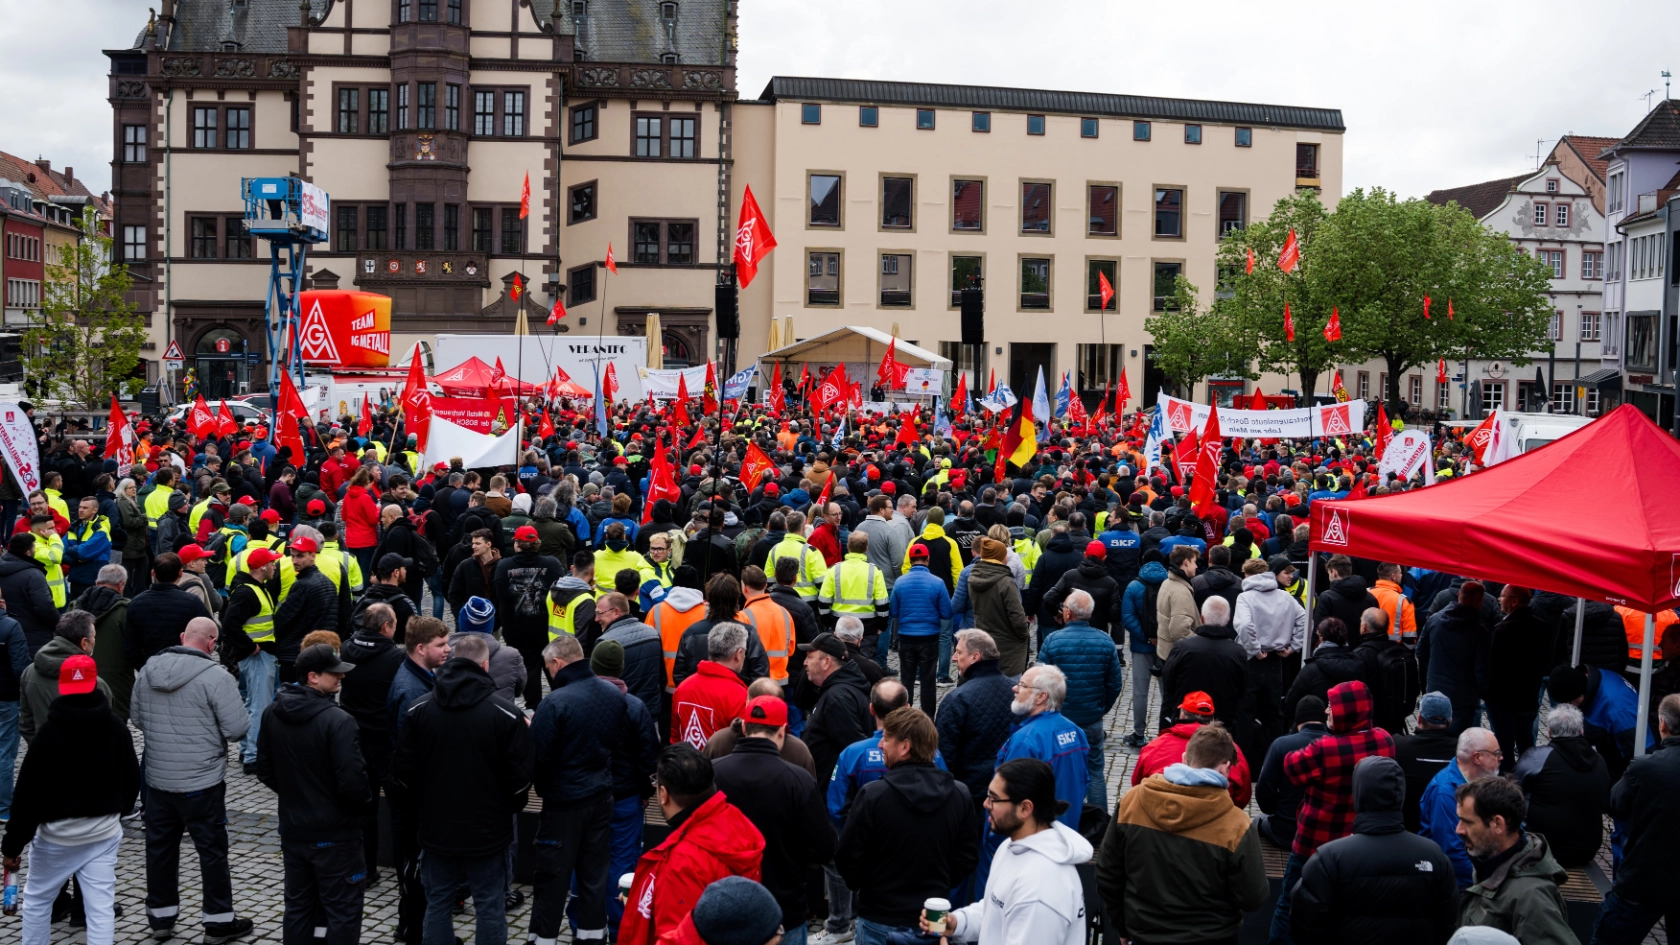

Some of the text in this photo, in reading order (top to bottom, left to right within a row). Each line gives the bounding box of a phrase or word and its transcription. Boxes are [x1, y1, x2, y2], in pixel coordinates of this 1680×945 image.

[351, 311, 374, 330] TEAM
[351, 333, 389, 354] IG METALL
[1110, 539, 1136, 547] SKF
[1057, 731, 1077, 746] SKF
